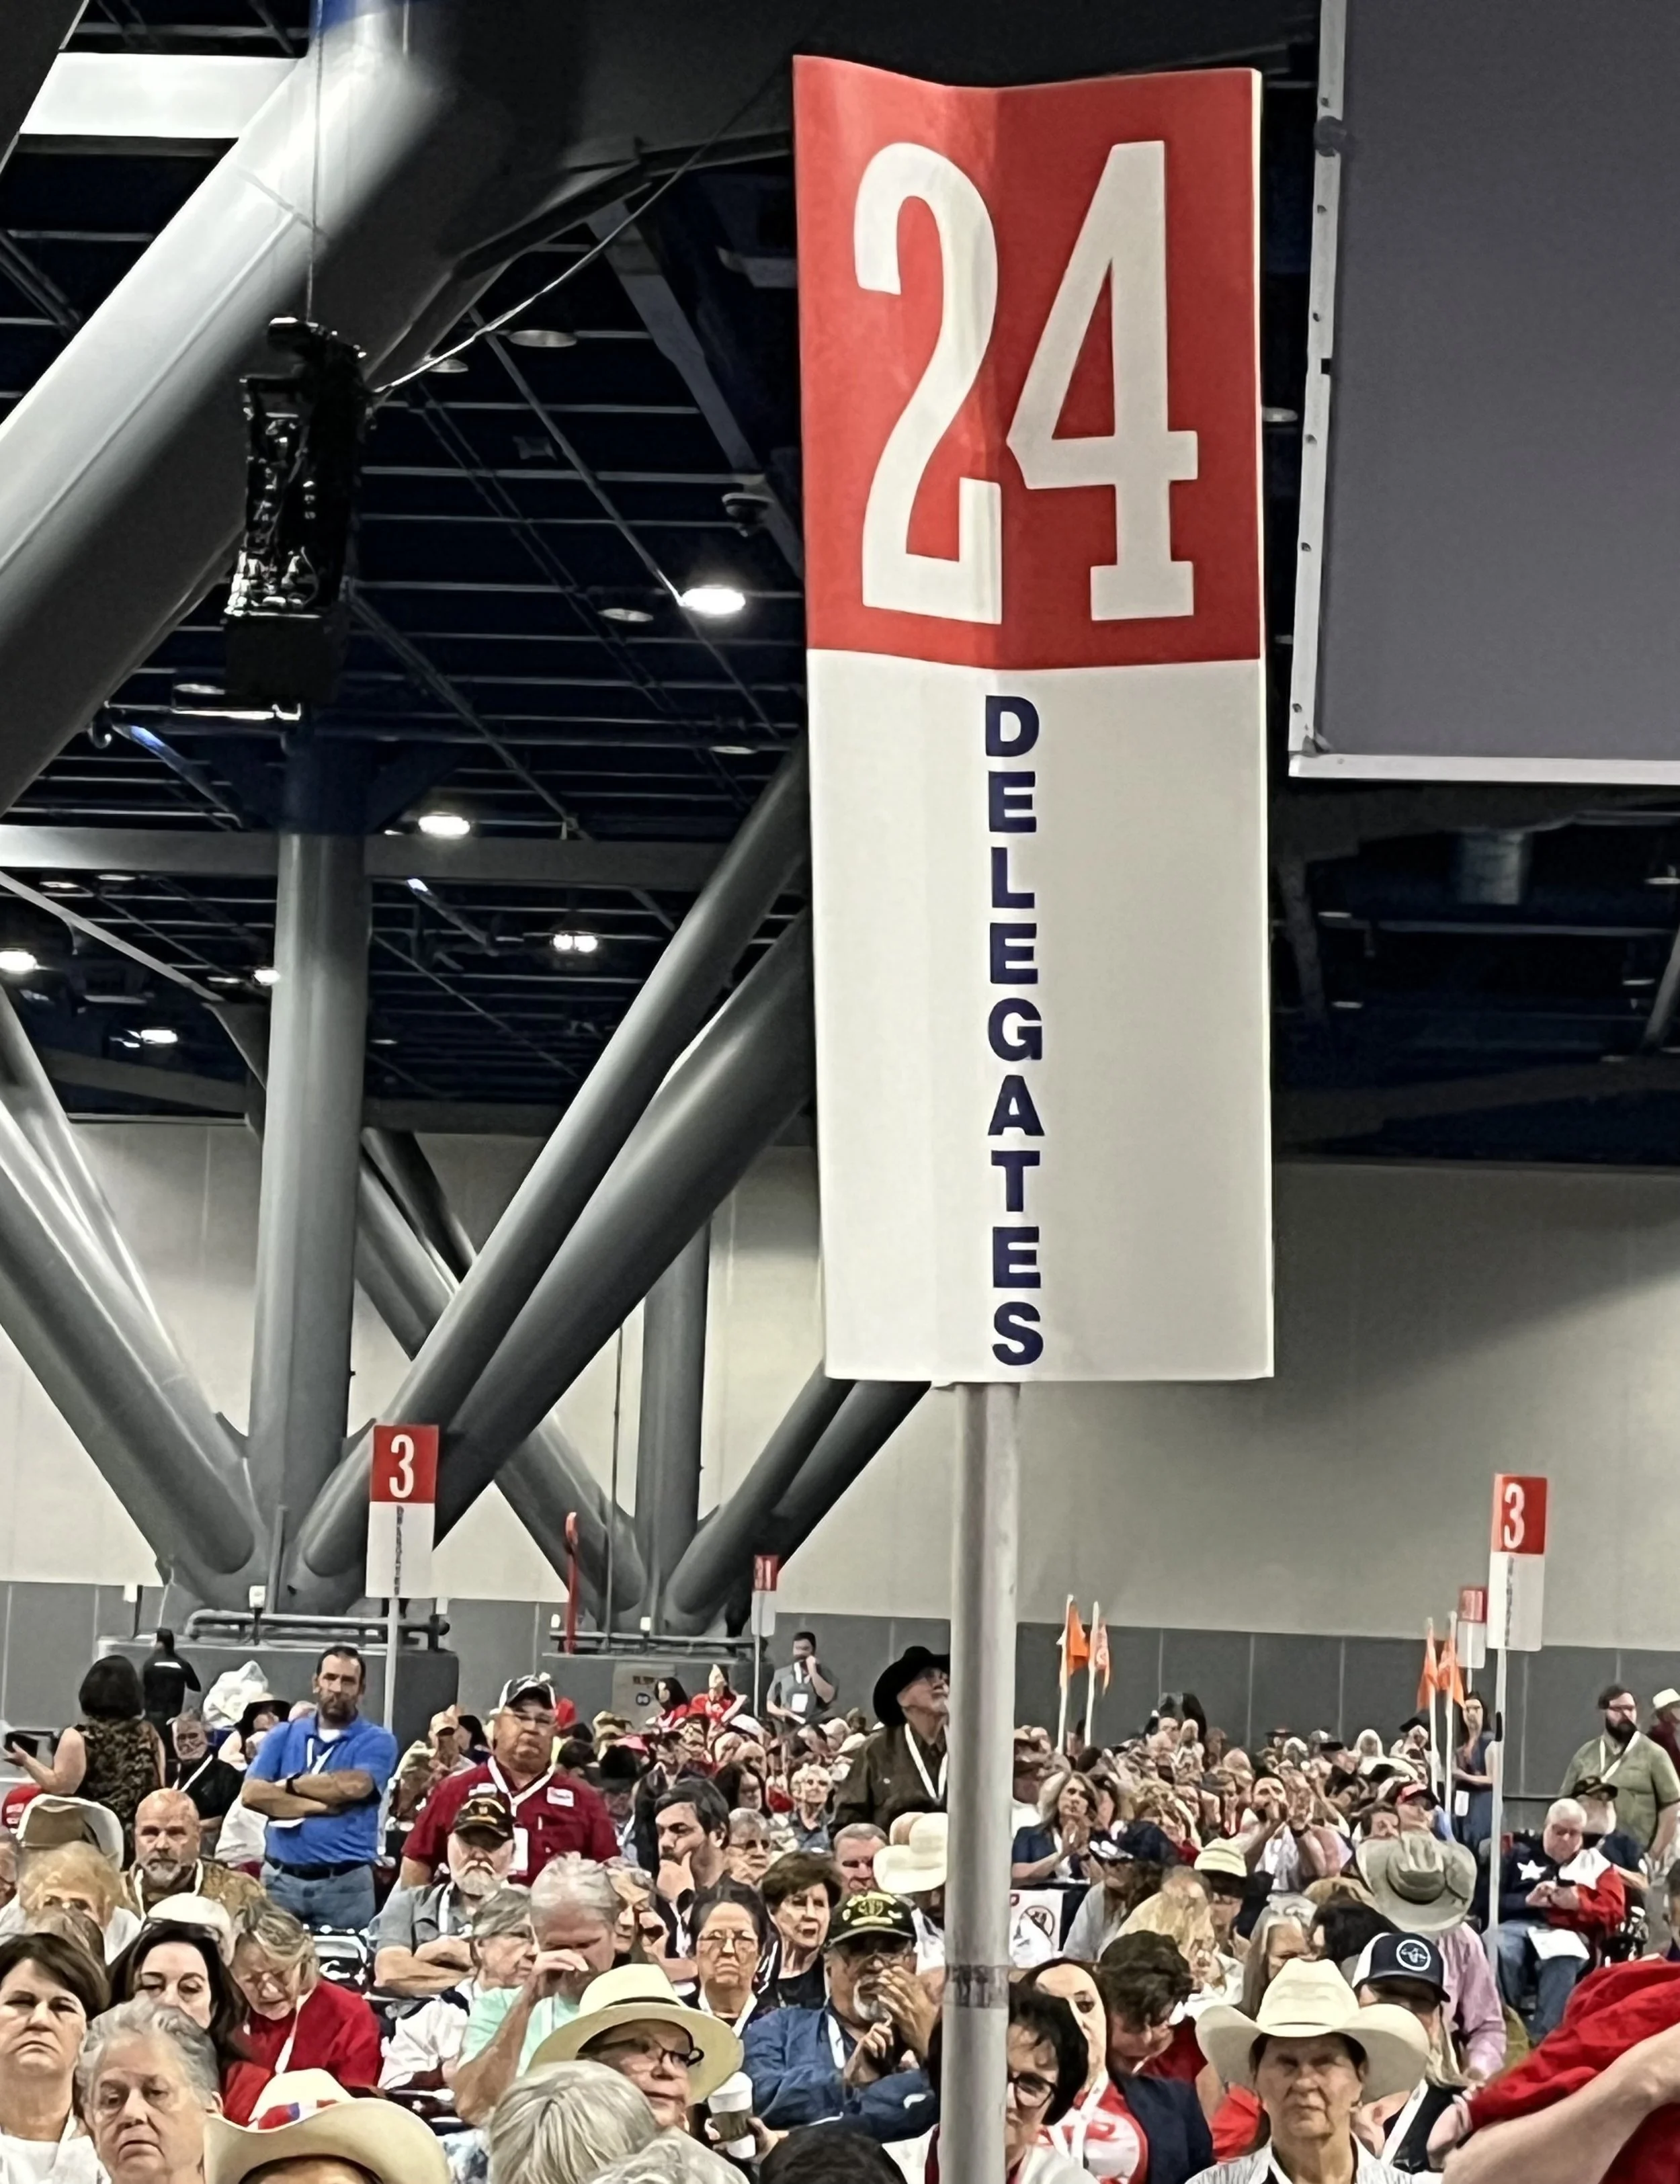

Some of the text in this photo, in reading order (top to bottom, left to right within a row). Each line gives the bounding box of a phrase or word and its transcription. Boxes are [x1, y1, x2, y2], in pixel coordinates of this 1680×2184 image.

[853, 140, 1198, 624] 24
[986, 695, 1045, 1366] DELEGATES
[388, 1434, 415, 1499] 3
[1503, 1482, 1525, 1550] 3
